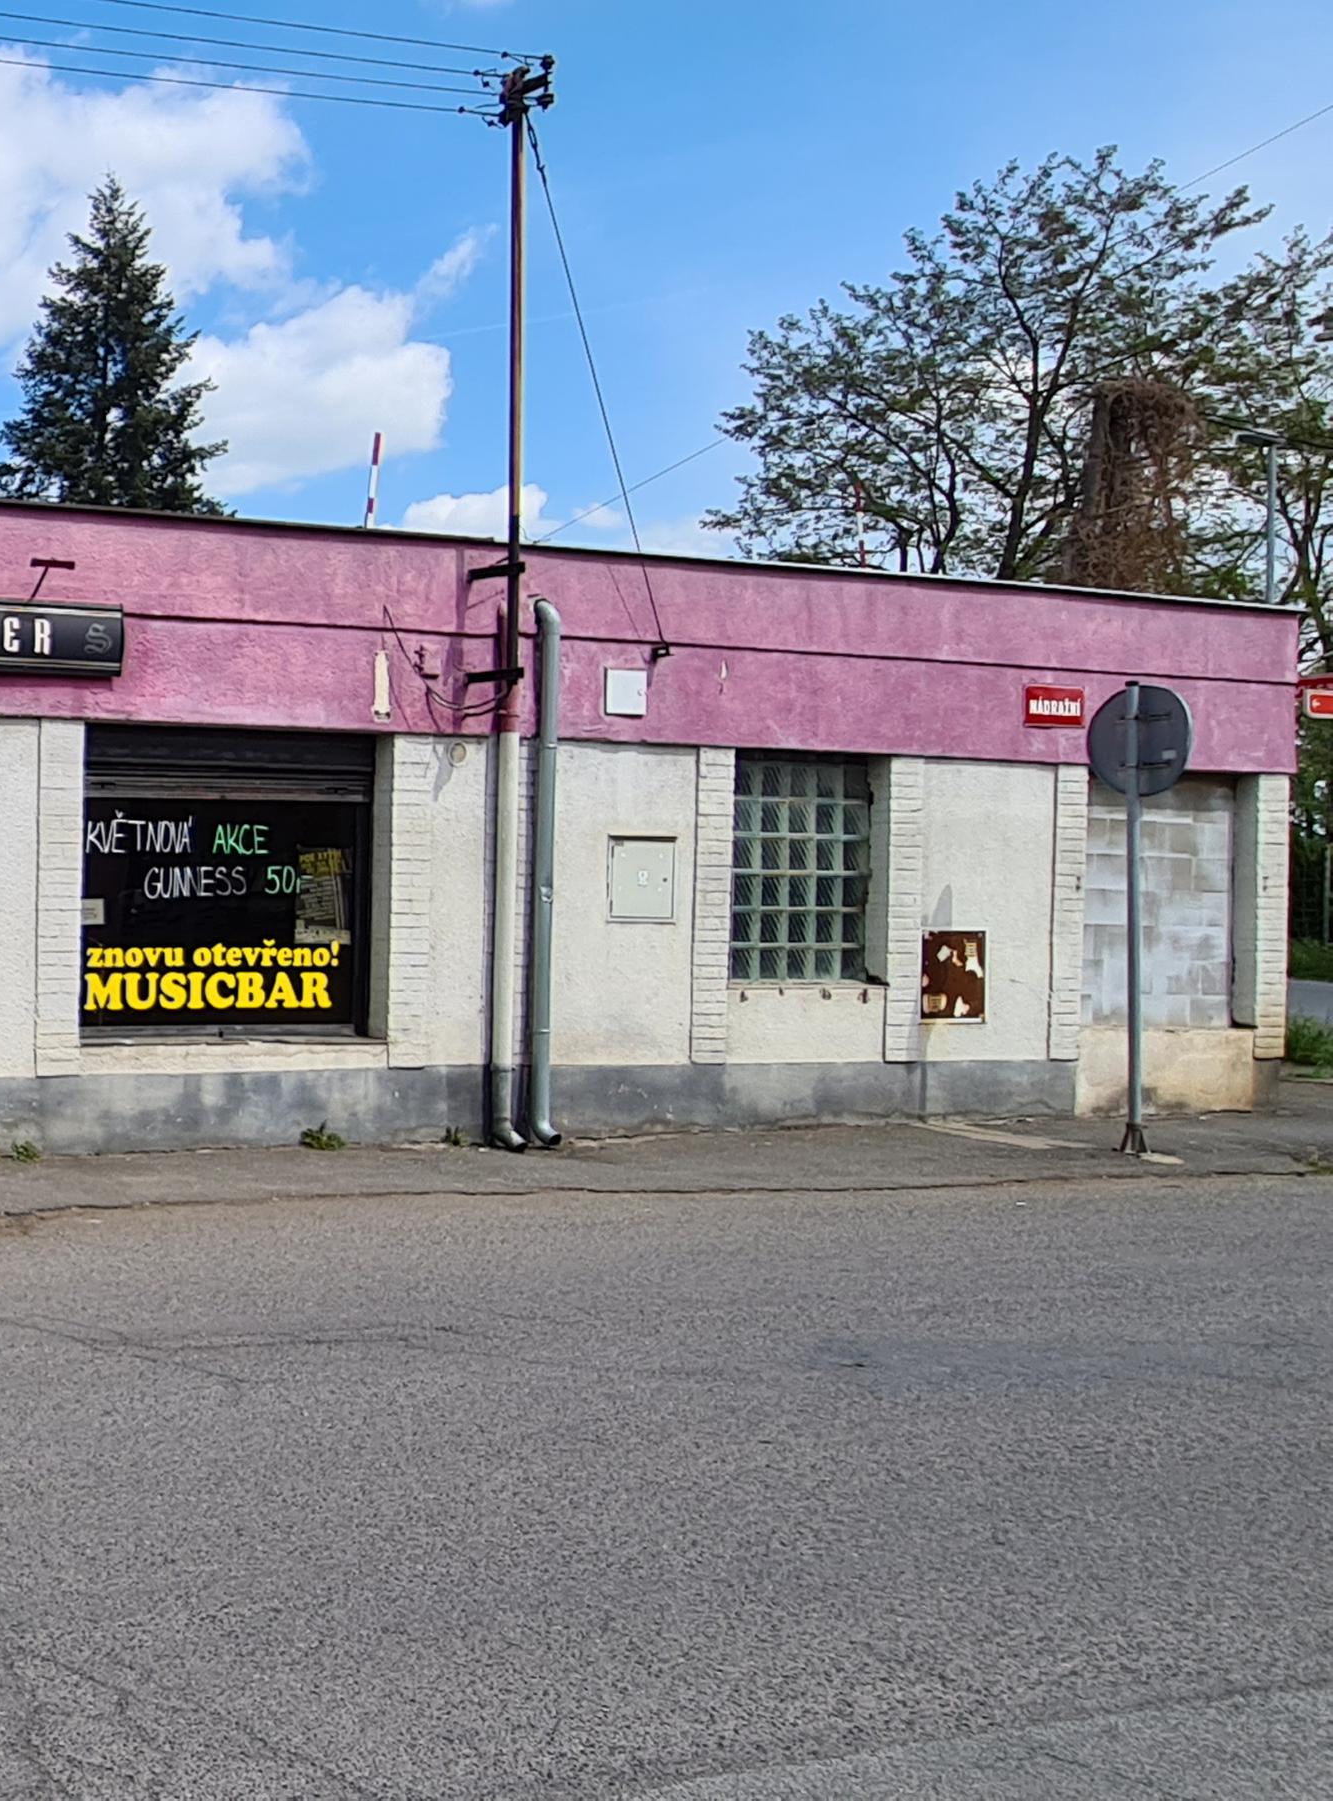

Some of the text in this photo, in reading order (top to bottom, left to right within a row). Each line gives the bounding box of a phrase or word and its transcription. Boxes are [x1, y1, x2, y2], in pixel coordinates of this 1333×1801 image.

[1029, 696, 1081, 717] NÁDRAŽNÍ
[85, 810, 270, 855] KVĚTNOVÁ AKCE
[87, 939, 340, 967] znovu otevřeno!
[84, 972, 332, 1011] MUSICBAR
